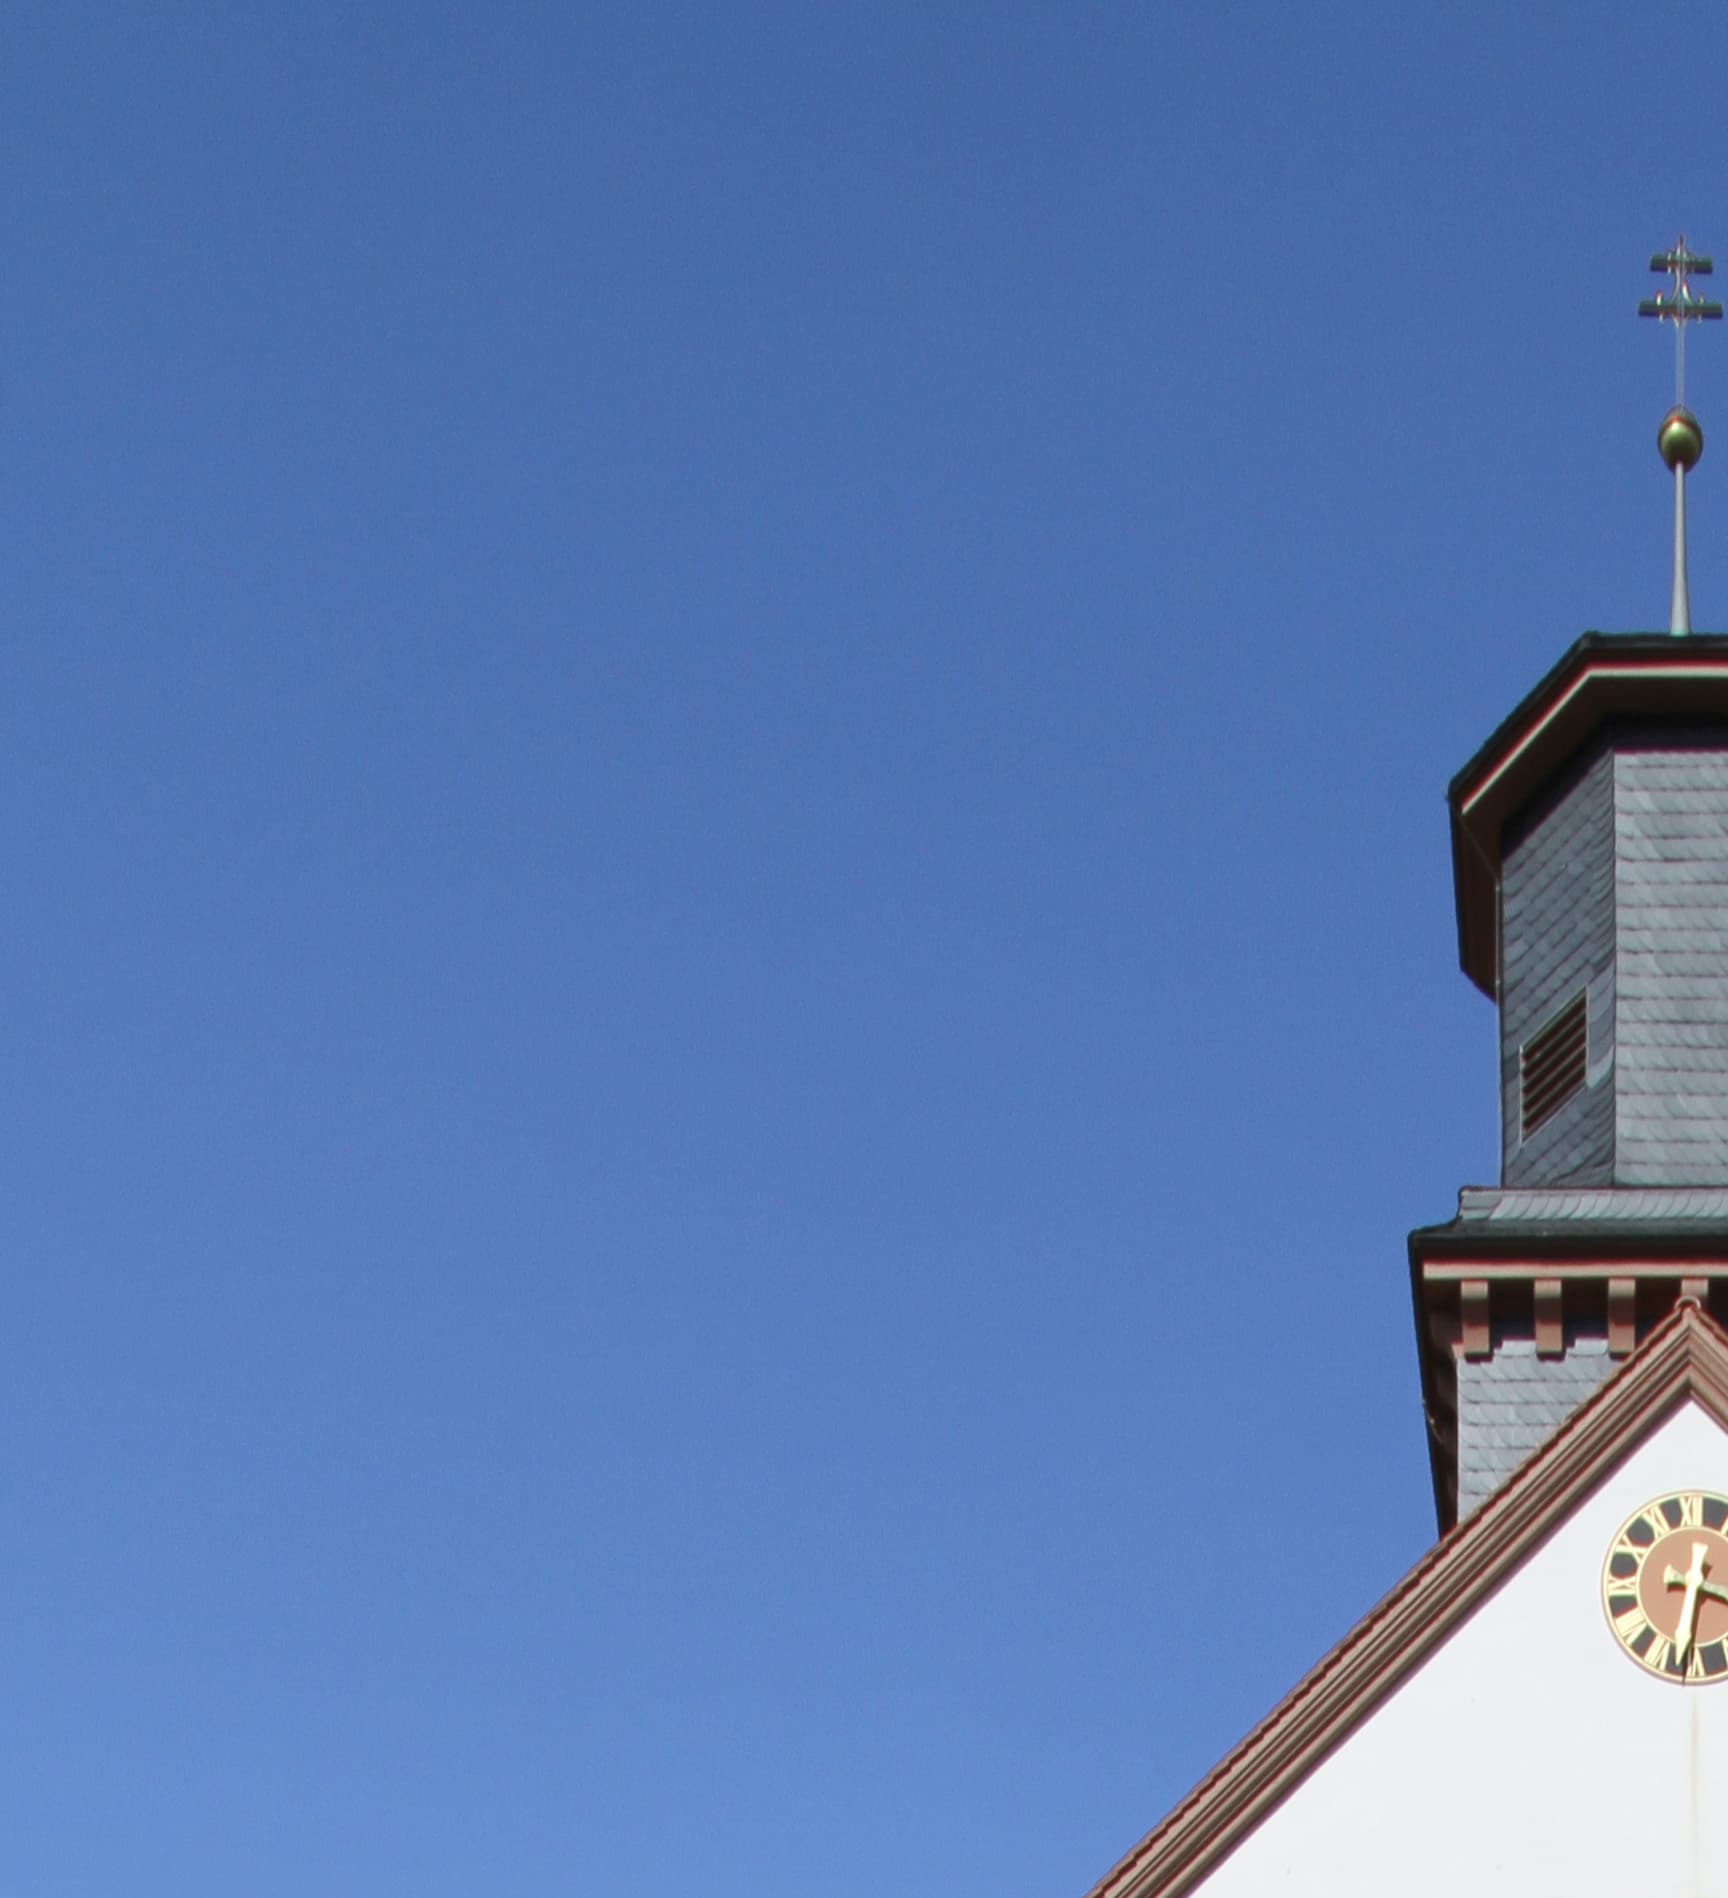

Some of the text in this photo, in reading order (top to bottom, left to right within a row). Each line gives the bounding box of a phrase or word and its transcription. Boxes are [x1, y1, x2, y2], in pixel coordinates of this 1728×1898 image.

[1642, 1503, 1672, 1540] XI
[1679, 1496, 1703, 1527] XII
[1614, 1533, 1648, 1564] X
